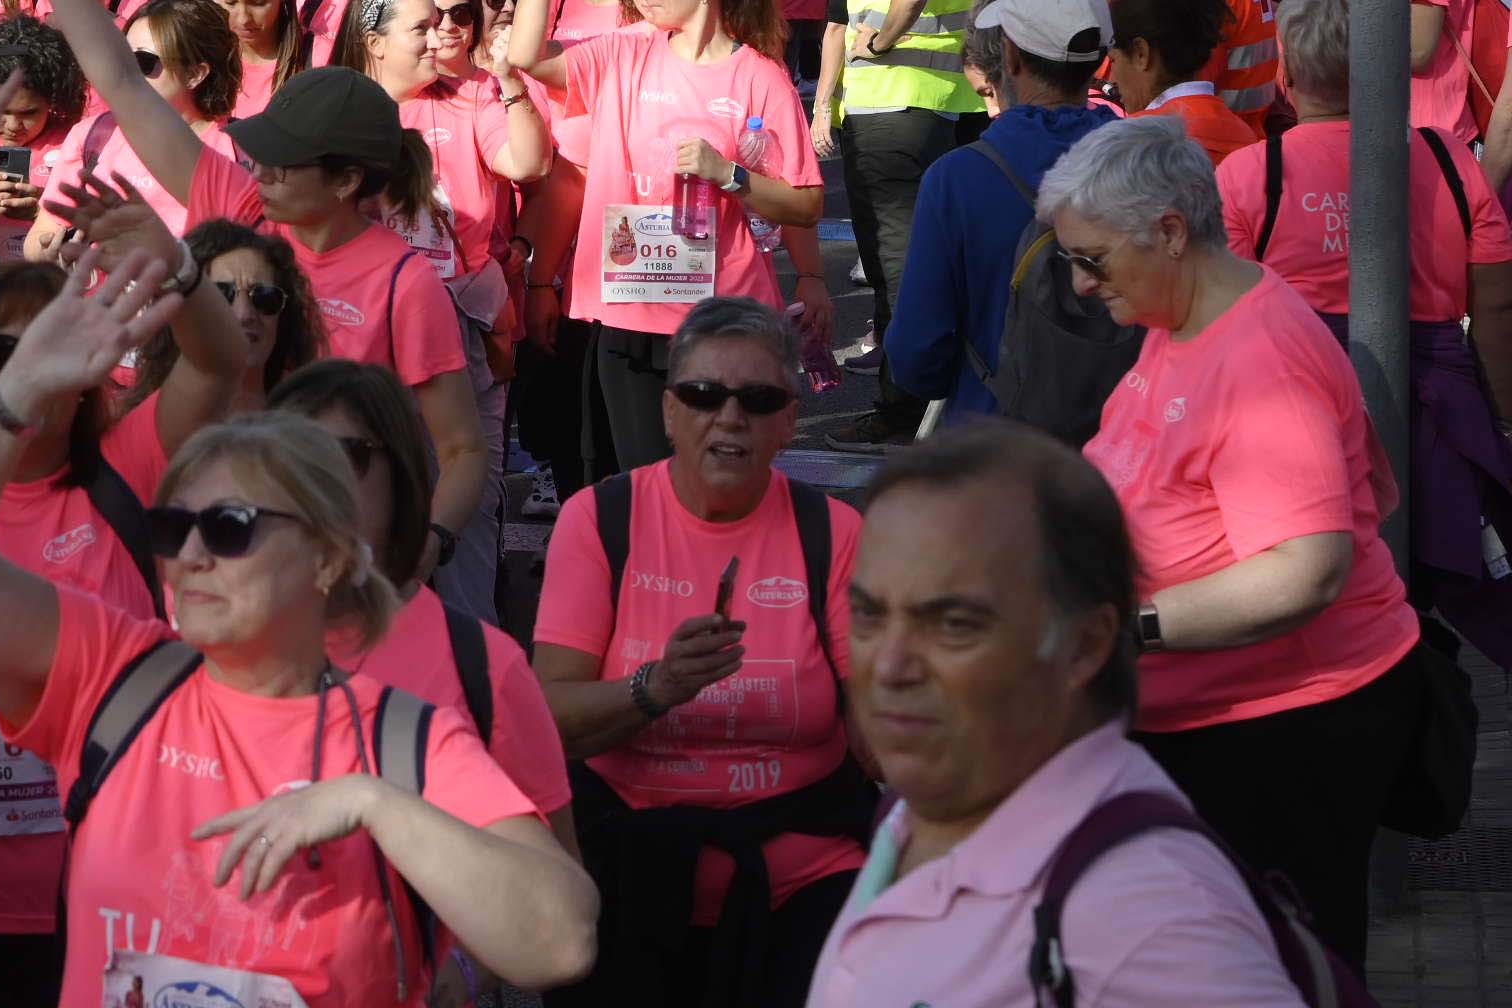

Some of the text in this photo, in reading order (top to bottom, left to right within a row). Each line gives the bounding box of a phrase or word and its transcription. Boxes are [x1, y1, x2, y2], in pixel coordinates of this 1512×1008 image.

[640, 244, 678, 258] 016
[644, 262, 673, 271] 11888
[666, 274, 688, 282] MUJER
[612, 287, 706, 296] OYSHO Santander
[729, 676, 777, 692] GASTEIZ
[727, 760, 782, 793] 2019
[99, 906, 162, 971] TU
